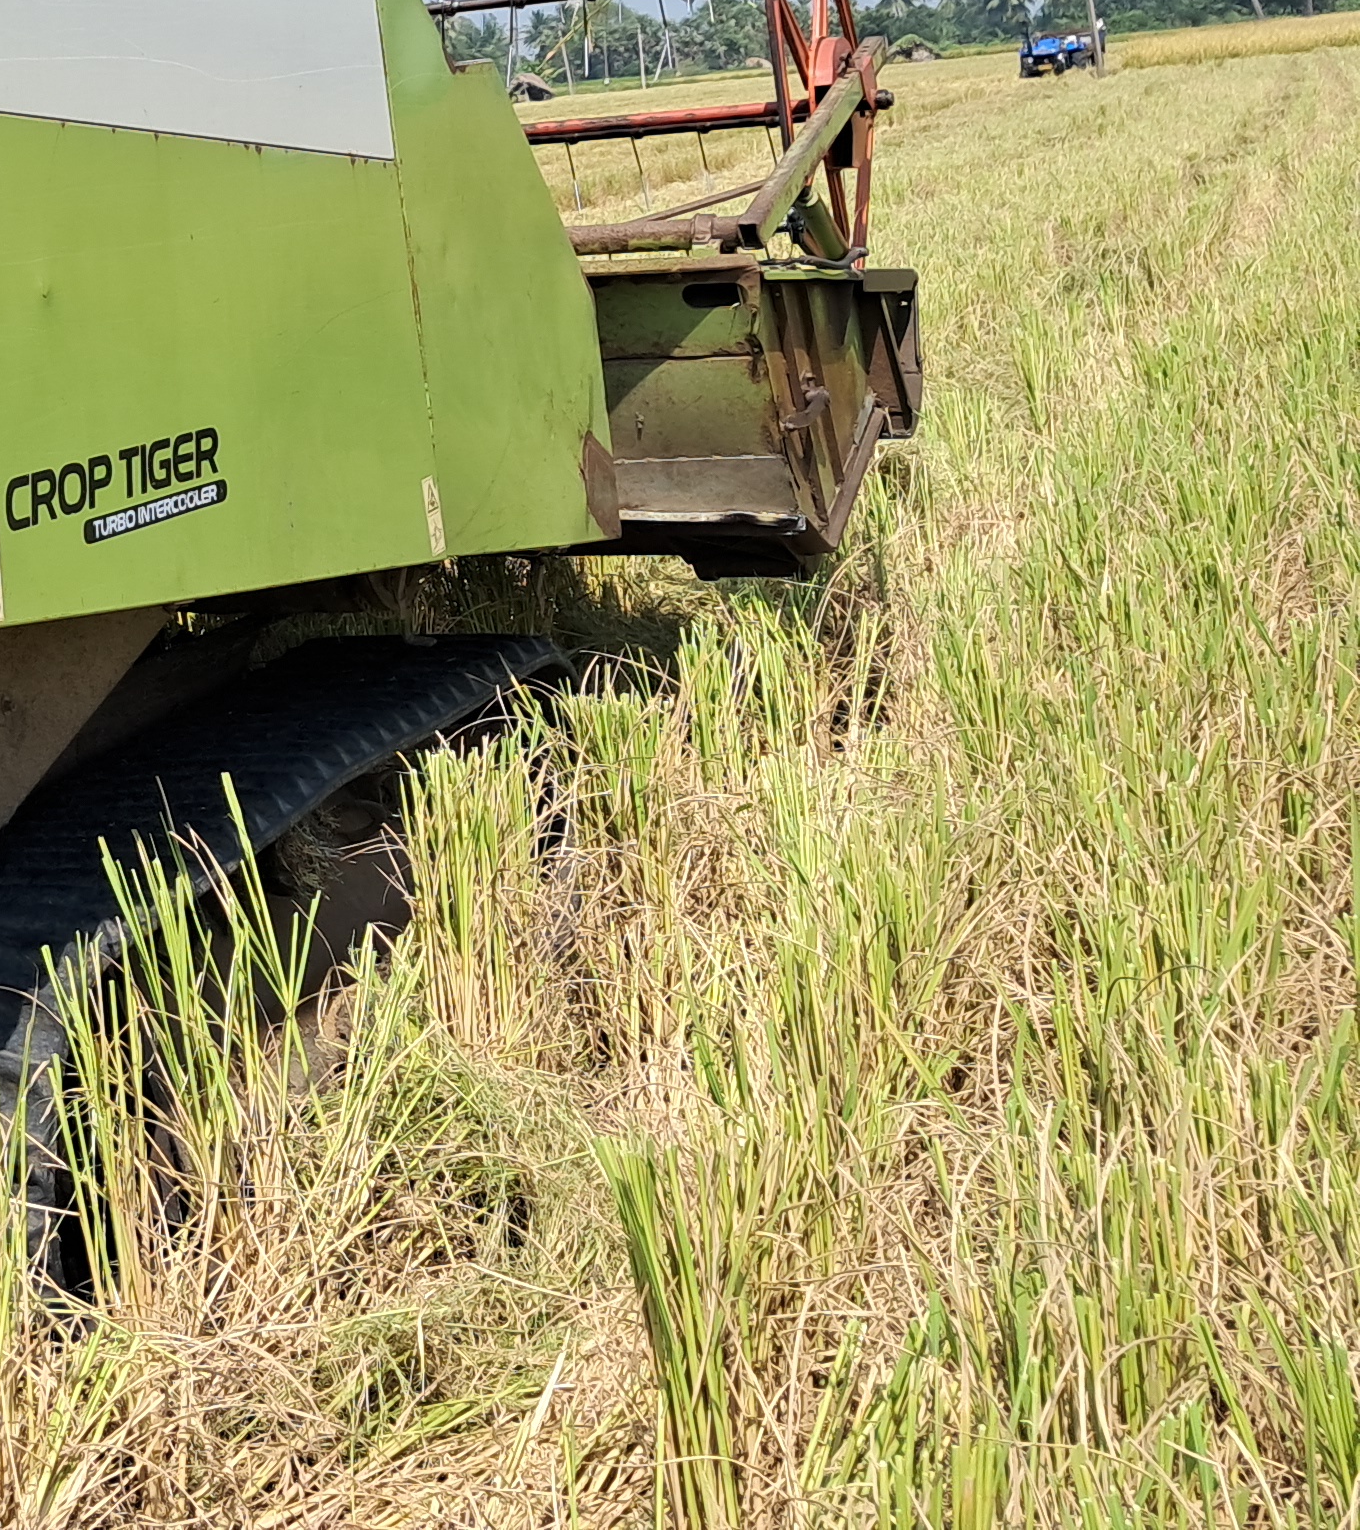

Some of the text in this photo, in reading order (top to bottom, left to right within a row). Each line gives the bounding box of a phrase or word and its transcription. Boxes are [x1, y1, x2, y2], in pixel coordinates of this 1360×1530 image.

[6, 427, 219, 531] CROP TIGER
[93, 484, 218, 539] TURBO INTERCOOLER
